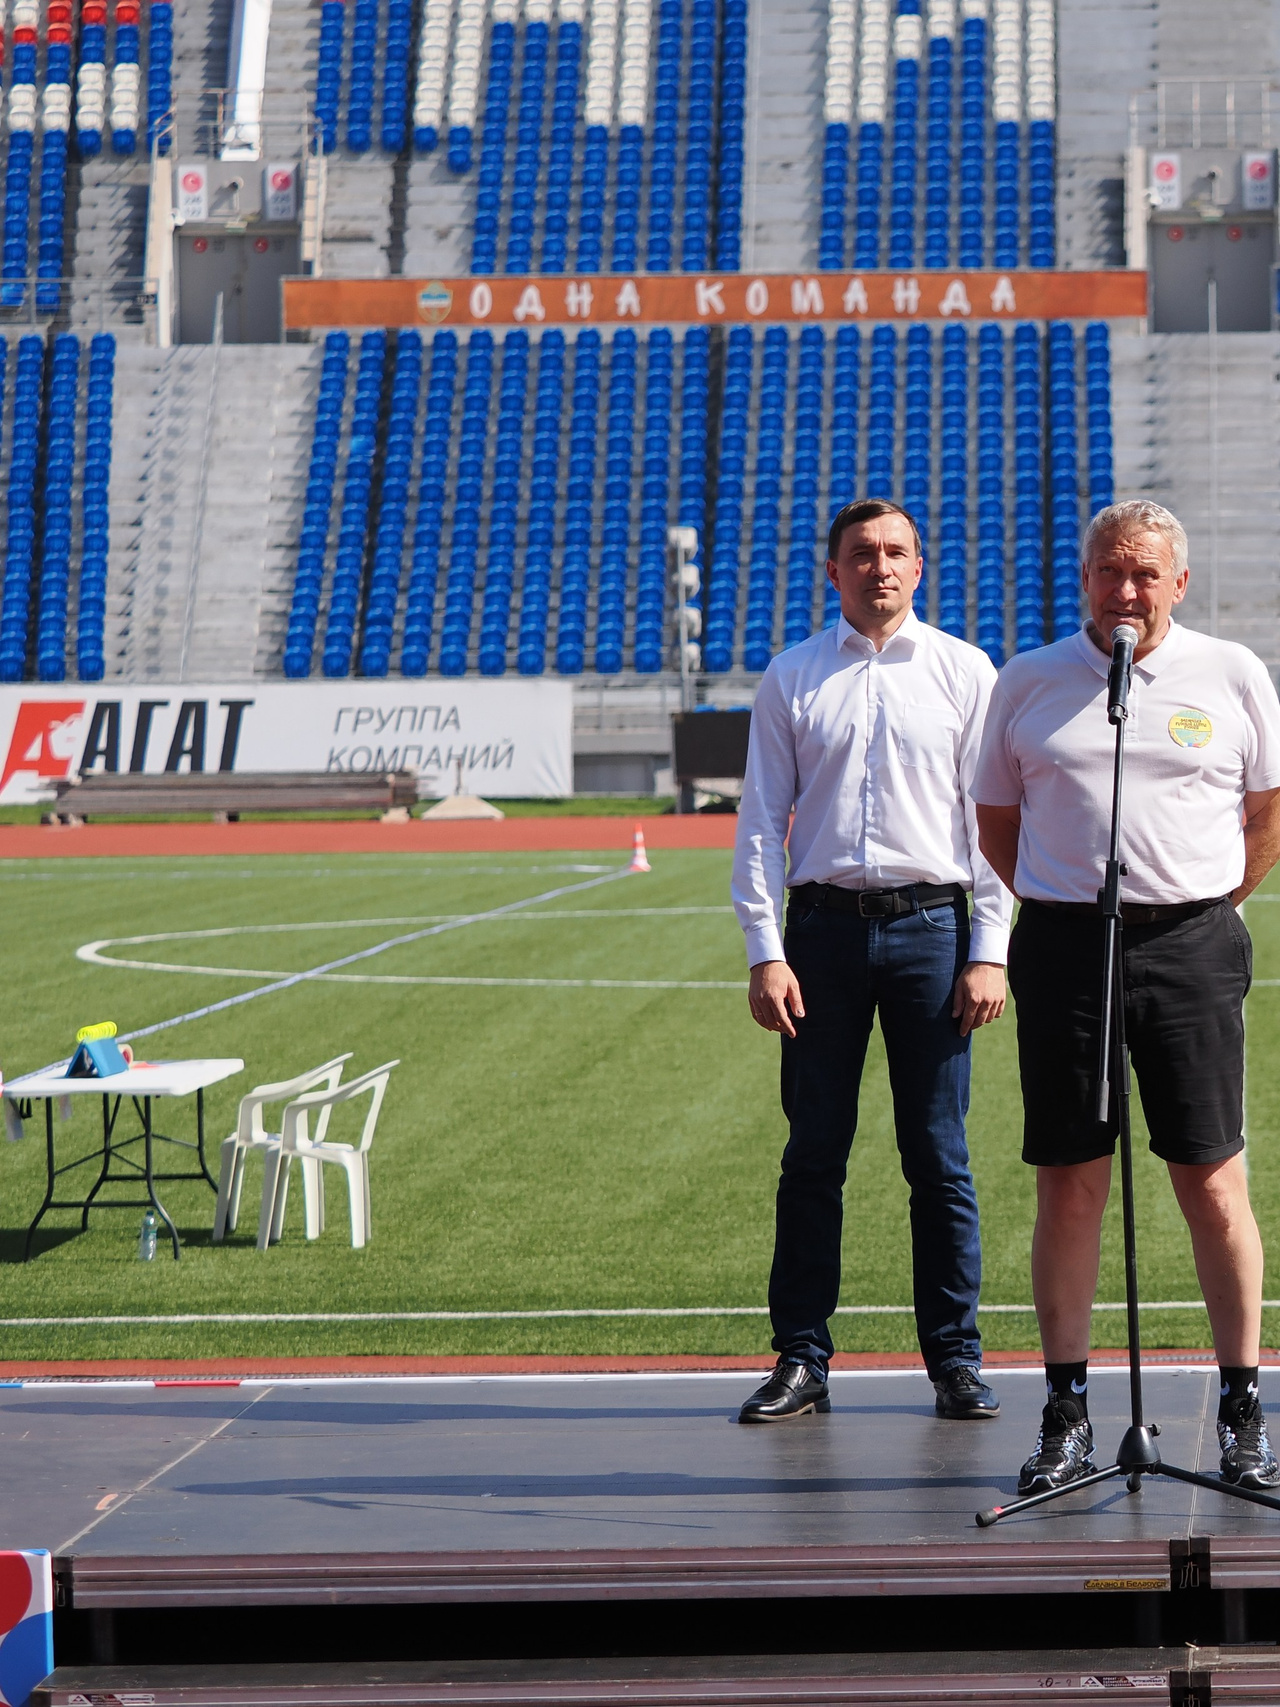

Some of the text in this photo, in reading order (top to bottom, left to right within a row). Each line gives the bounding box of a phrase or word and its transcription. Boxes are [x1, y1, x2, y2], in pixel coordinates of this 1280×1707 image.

[469, 276, 1017, 322] ОДНА КОМАНДА
[80, 699, 256, 774] АГАТ
[333, 705, 461, 735] ГРУППА
[325, 737, 516, 773] КОМПАНИЙ
